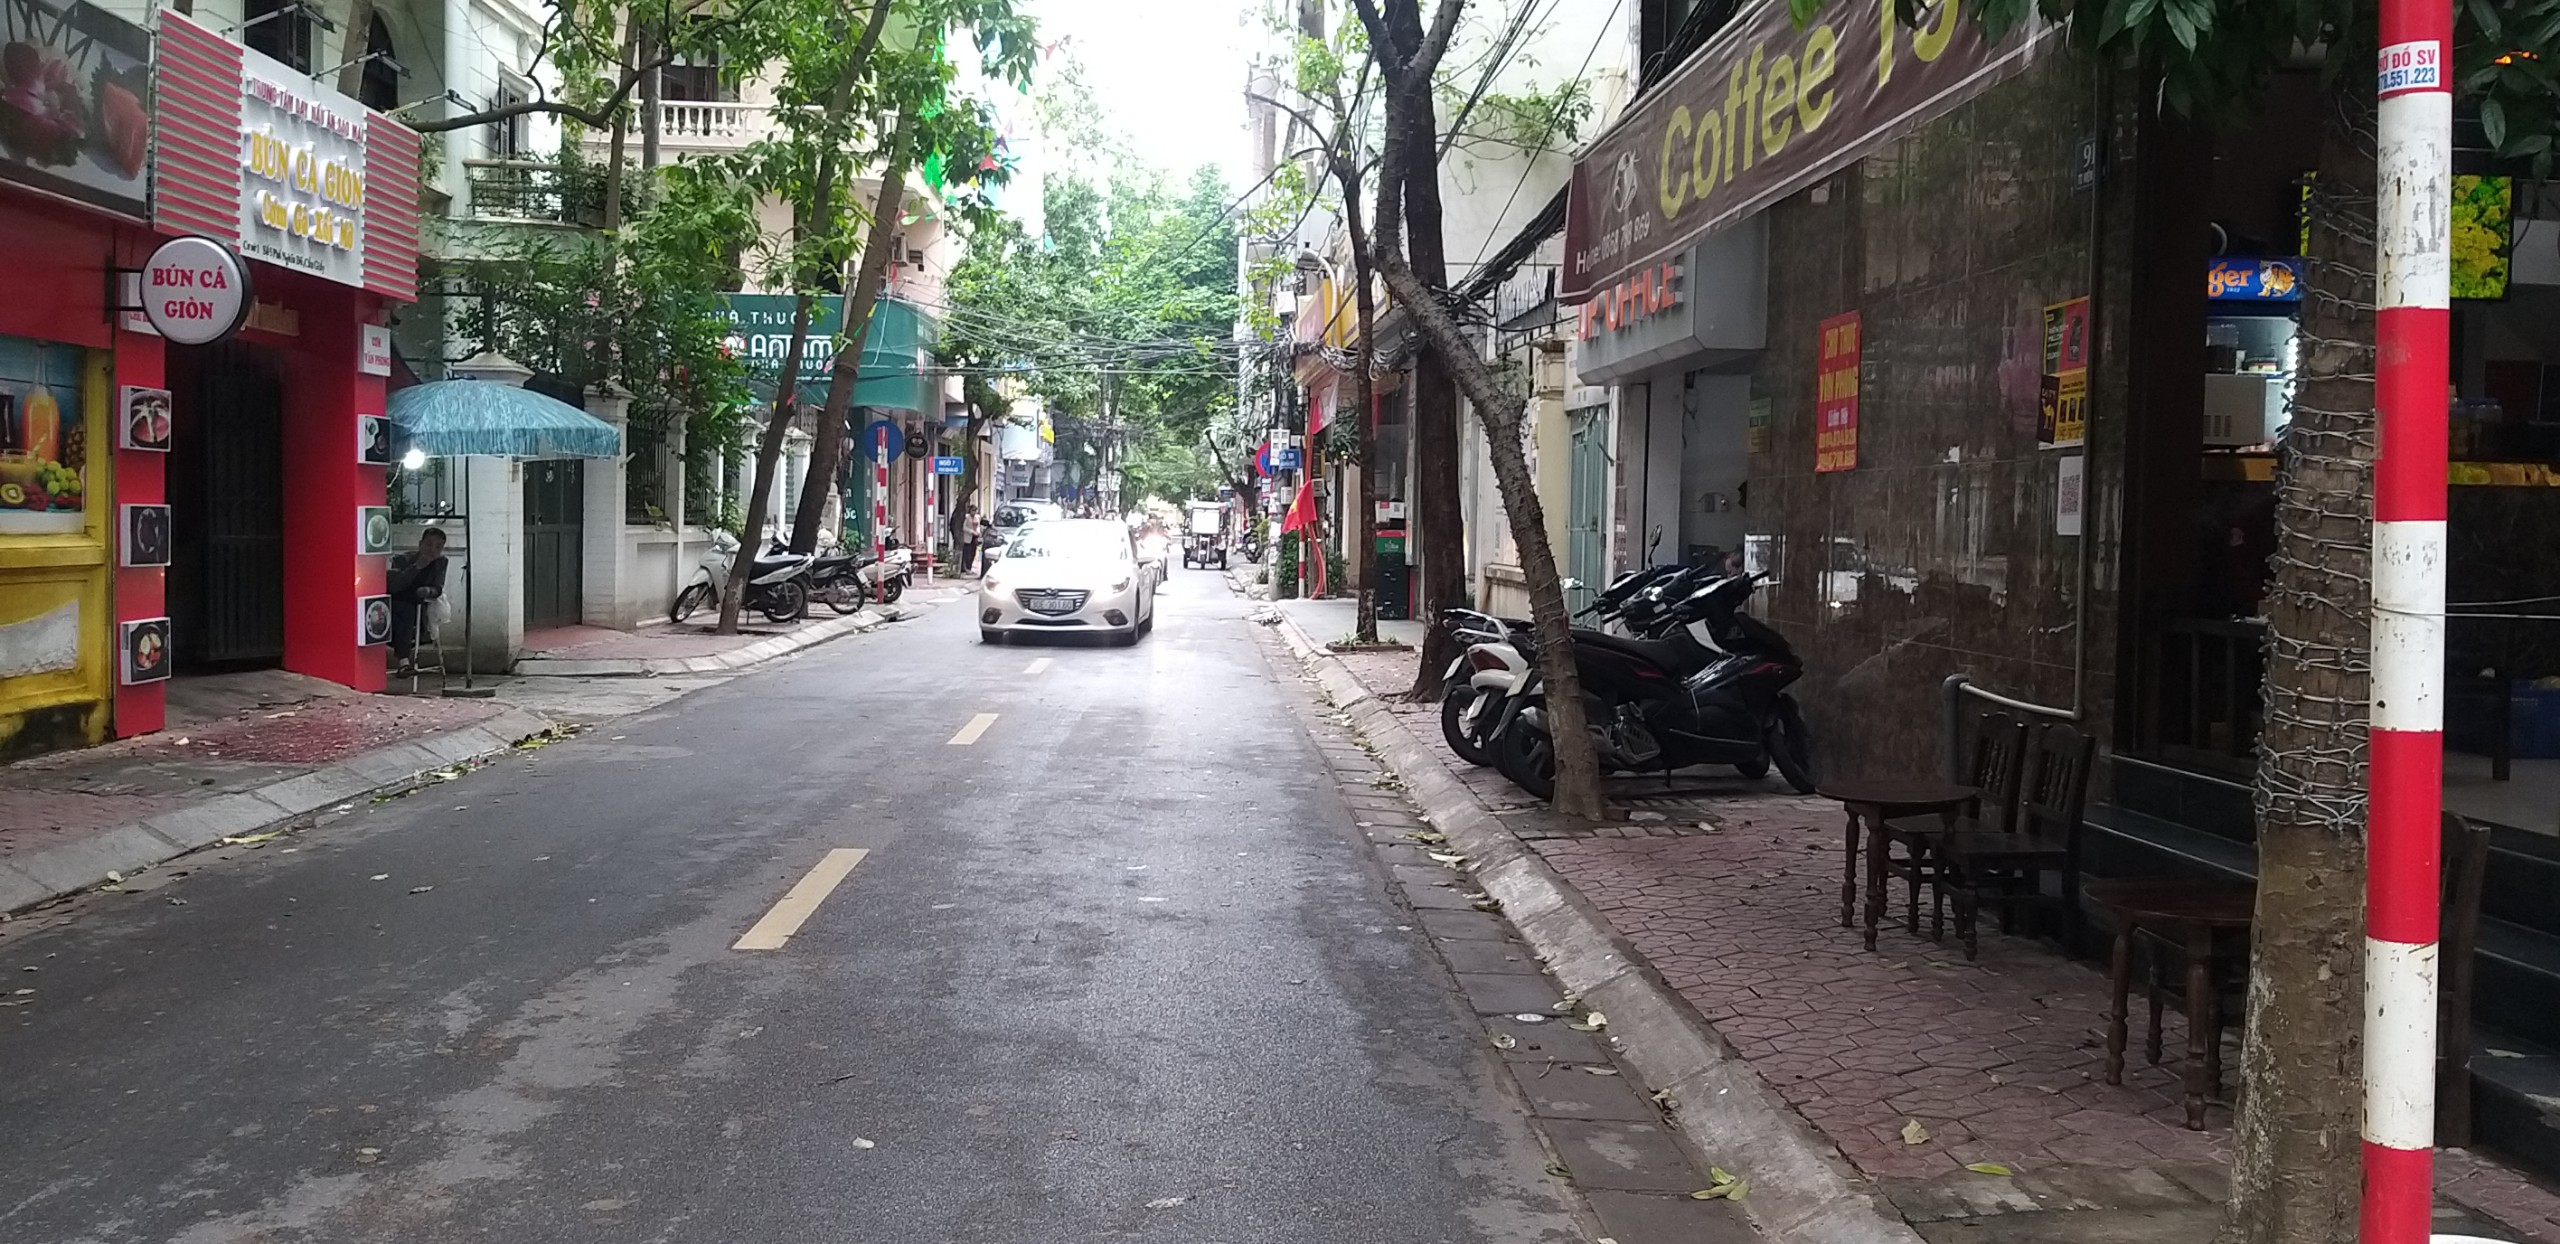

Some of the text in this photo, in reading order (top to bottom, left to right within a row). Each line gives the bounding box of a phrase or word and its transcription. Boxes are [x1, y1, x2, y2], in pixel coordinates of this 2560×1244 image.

[2417, 48, 2436, 66] SV
[1661, 25, 1836, 220] Coffee
[251, 125, 363, 210] BÚN CÁ GIÒN
[152, 263, 227, 289] BÚN CÁ
[2208, 261, 2254, 297] ger
[164, 296, 214, 320] GIÒN
